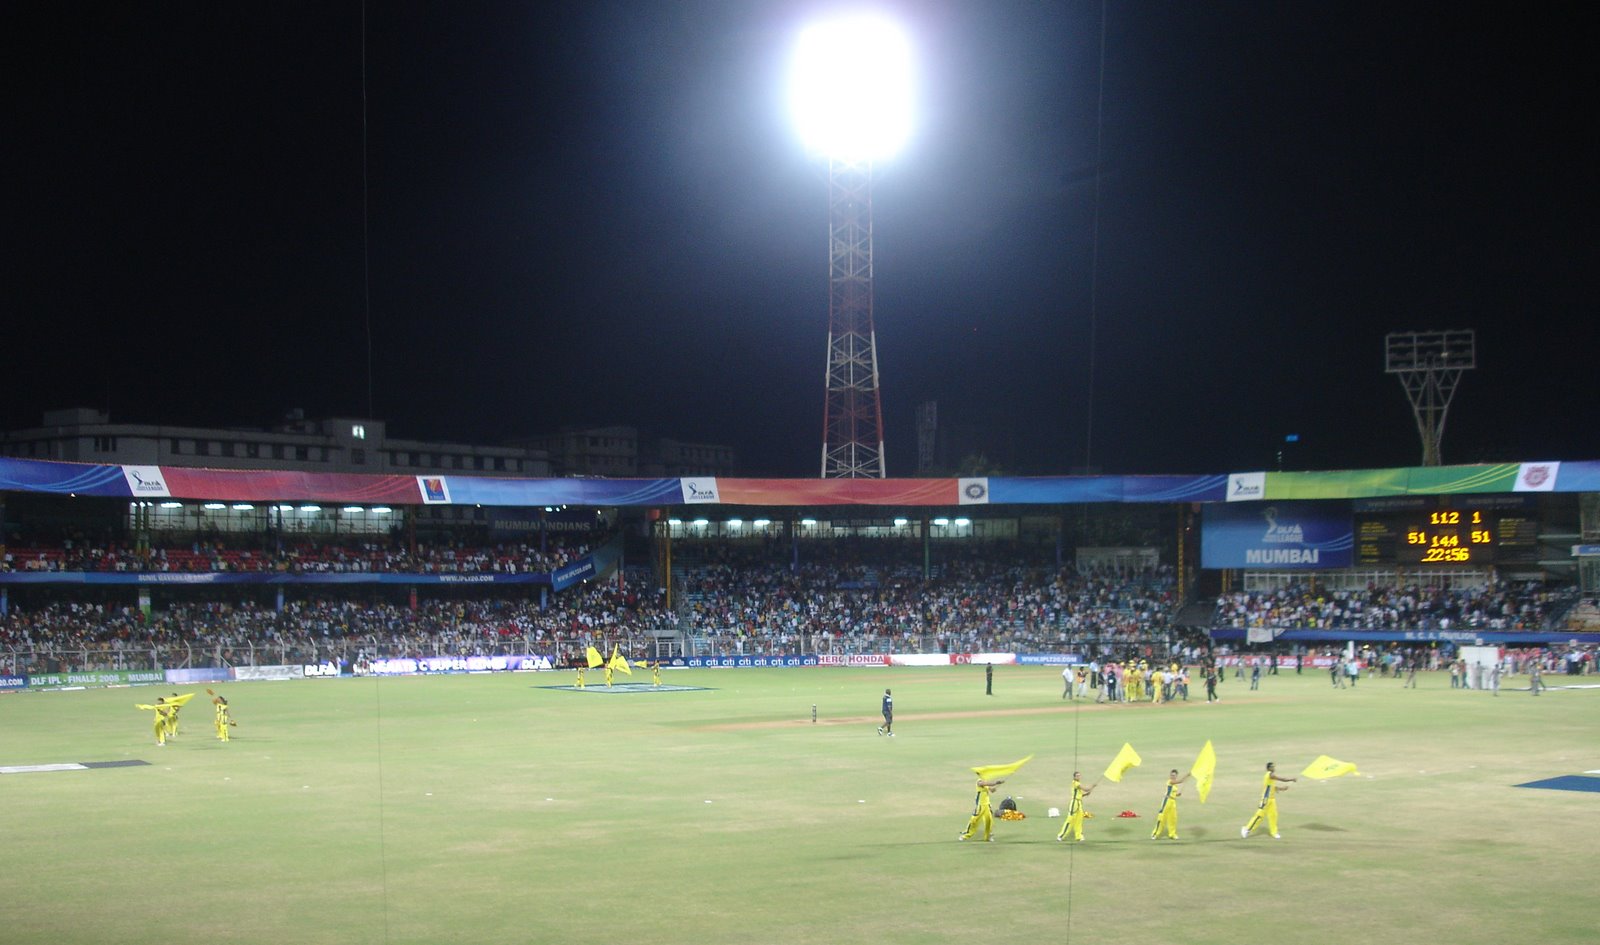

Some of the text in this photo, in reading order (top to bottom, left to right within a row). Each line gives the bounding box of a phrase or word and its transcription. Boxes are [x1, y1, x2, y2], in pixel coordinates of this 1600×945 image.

[1430, 511, 1460, 524] 112
[1471, 511, 1481, 524] 1
[494, 520, 540, 530] MUMBAI
[1408, 531, 1426, 544] 51
[1471, 530, 1490, 543] 51
[1246, 549, 1319, 563] MUMBAI
[1424, 547, 1470, 562] 22:56
[429, 659, 467, 671] SUPER
[689, 658, 701, 666] citi
[706, 658, 718, 666] citi
[722, 658, 735, 666] citi
[738, 658, 751, 666] citi
[755, 658, 767, 666] citi
[771, 658, 784, 666] citi
[788, 658, 800, 666] citi
[848, 654, 884, 664] HONDA
[30, 677, 46, 686] DLF
[49, 675, 62, 684] IPL
[68, 673, 97, 683] FINALS
[100, 674, 119, 682] 2008
[128, 672, 163, 681] MUMBAI
